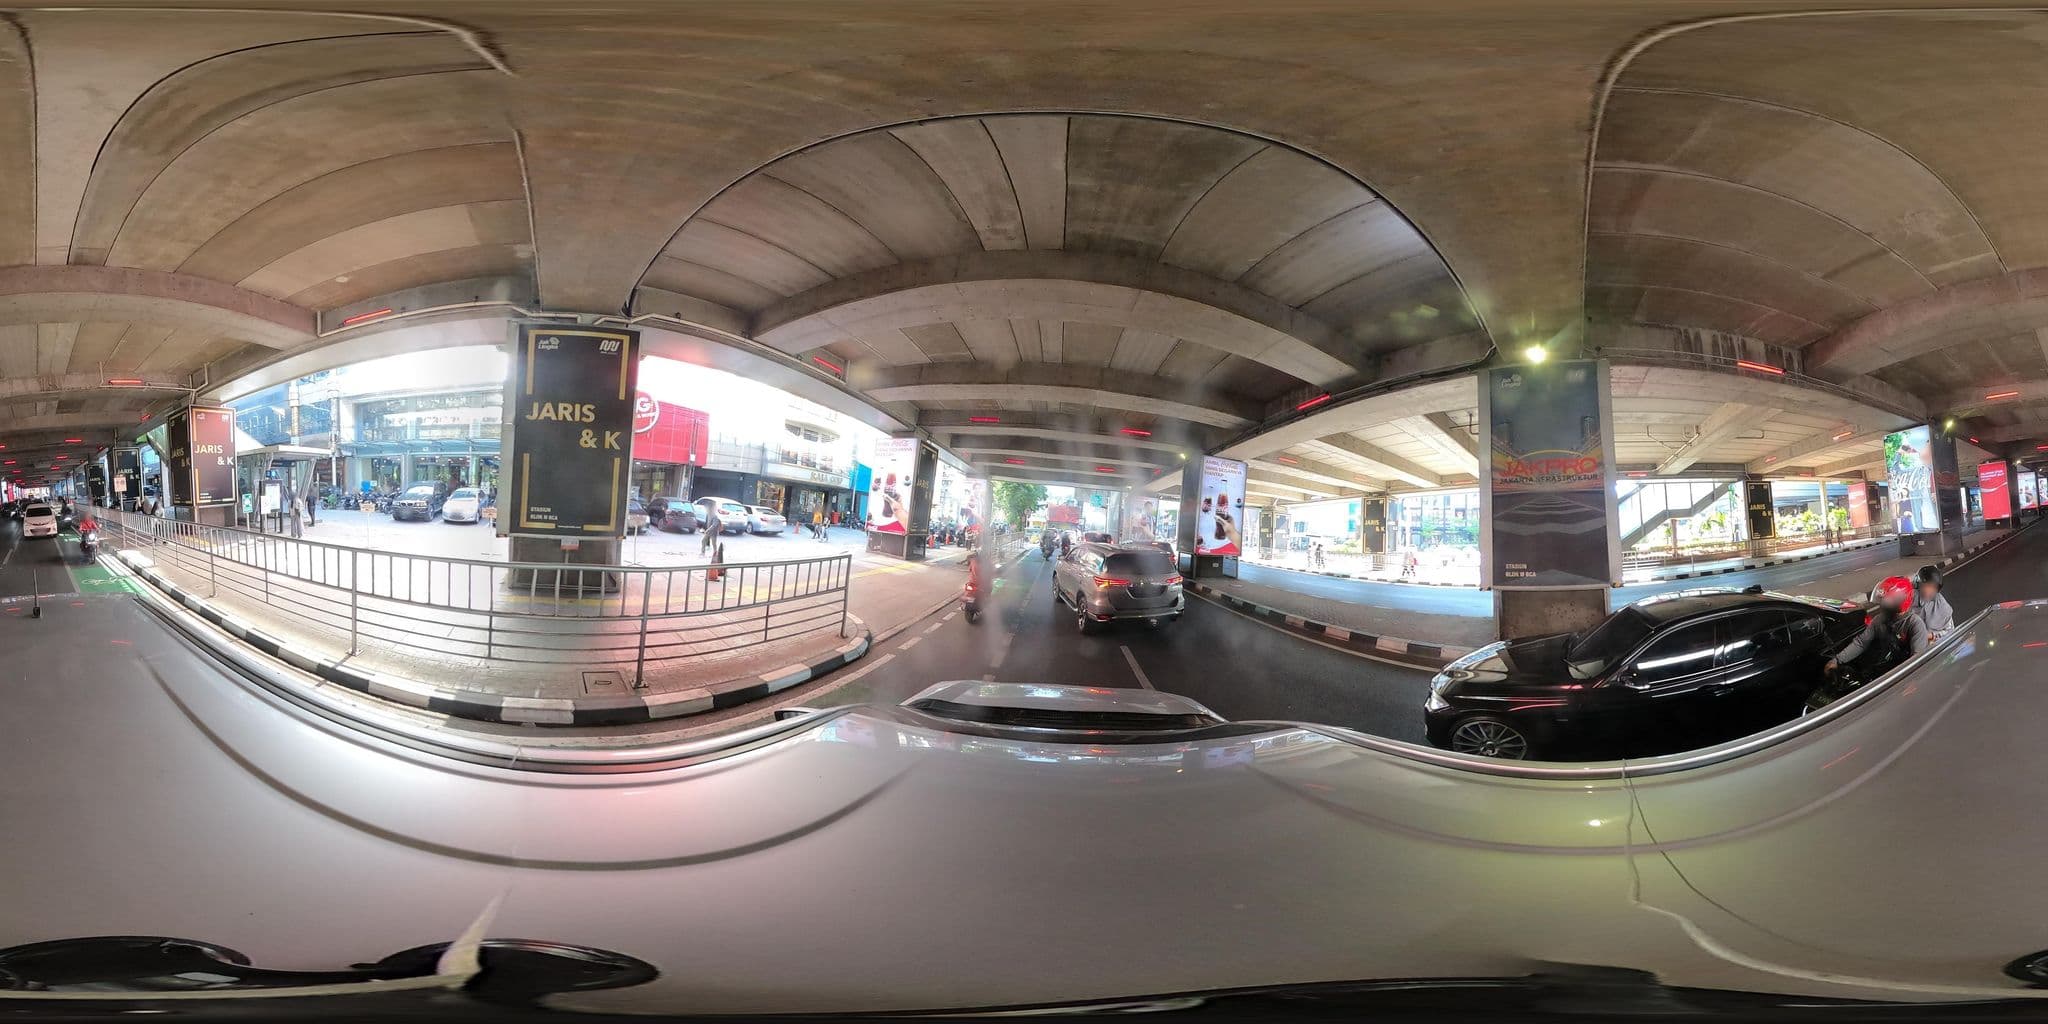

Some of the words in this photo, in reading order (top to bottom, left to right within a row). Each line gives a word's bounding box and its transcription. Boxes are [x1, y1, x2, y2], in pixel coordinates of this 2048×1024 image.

[526, 401, 596, 423] JARIS
[194, 444, 223, 454] JARIS
[579, 429, 598, 449] &
[604, 430, 622, 450] K
[217, 456, 225, 466] &
[226, 456, 235, 466] K
[1499, 457, 1598, 478] JAKPRO
